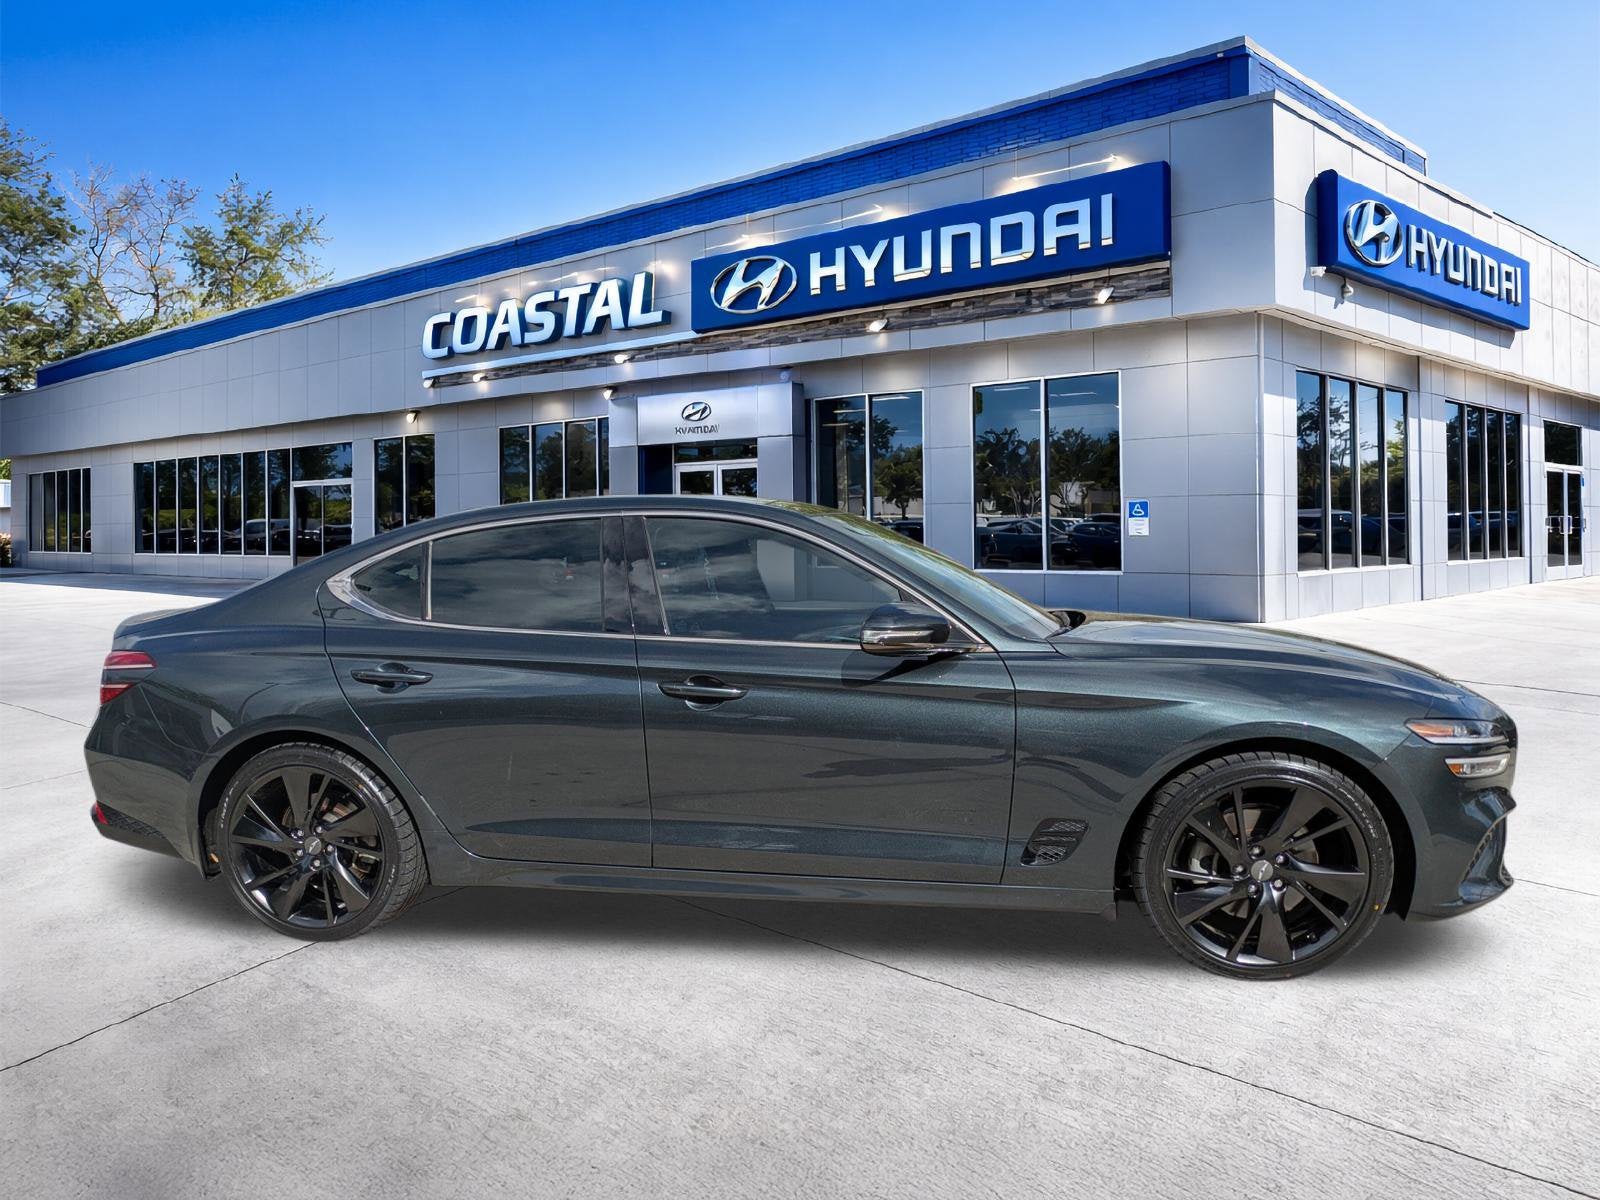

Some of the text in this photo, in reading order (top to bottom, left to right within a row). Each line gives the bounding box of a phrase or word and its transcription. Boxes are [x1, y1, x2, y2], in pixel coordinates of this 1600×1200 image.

[810, 193, 1113, 295] HYUNDAI
[1405, 224, 1522, 306] HYUNDAI
[422, 271, 671, 359] COASTAL
